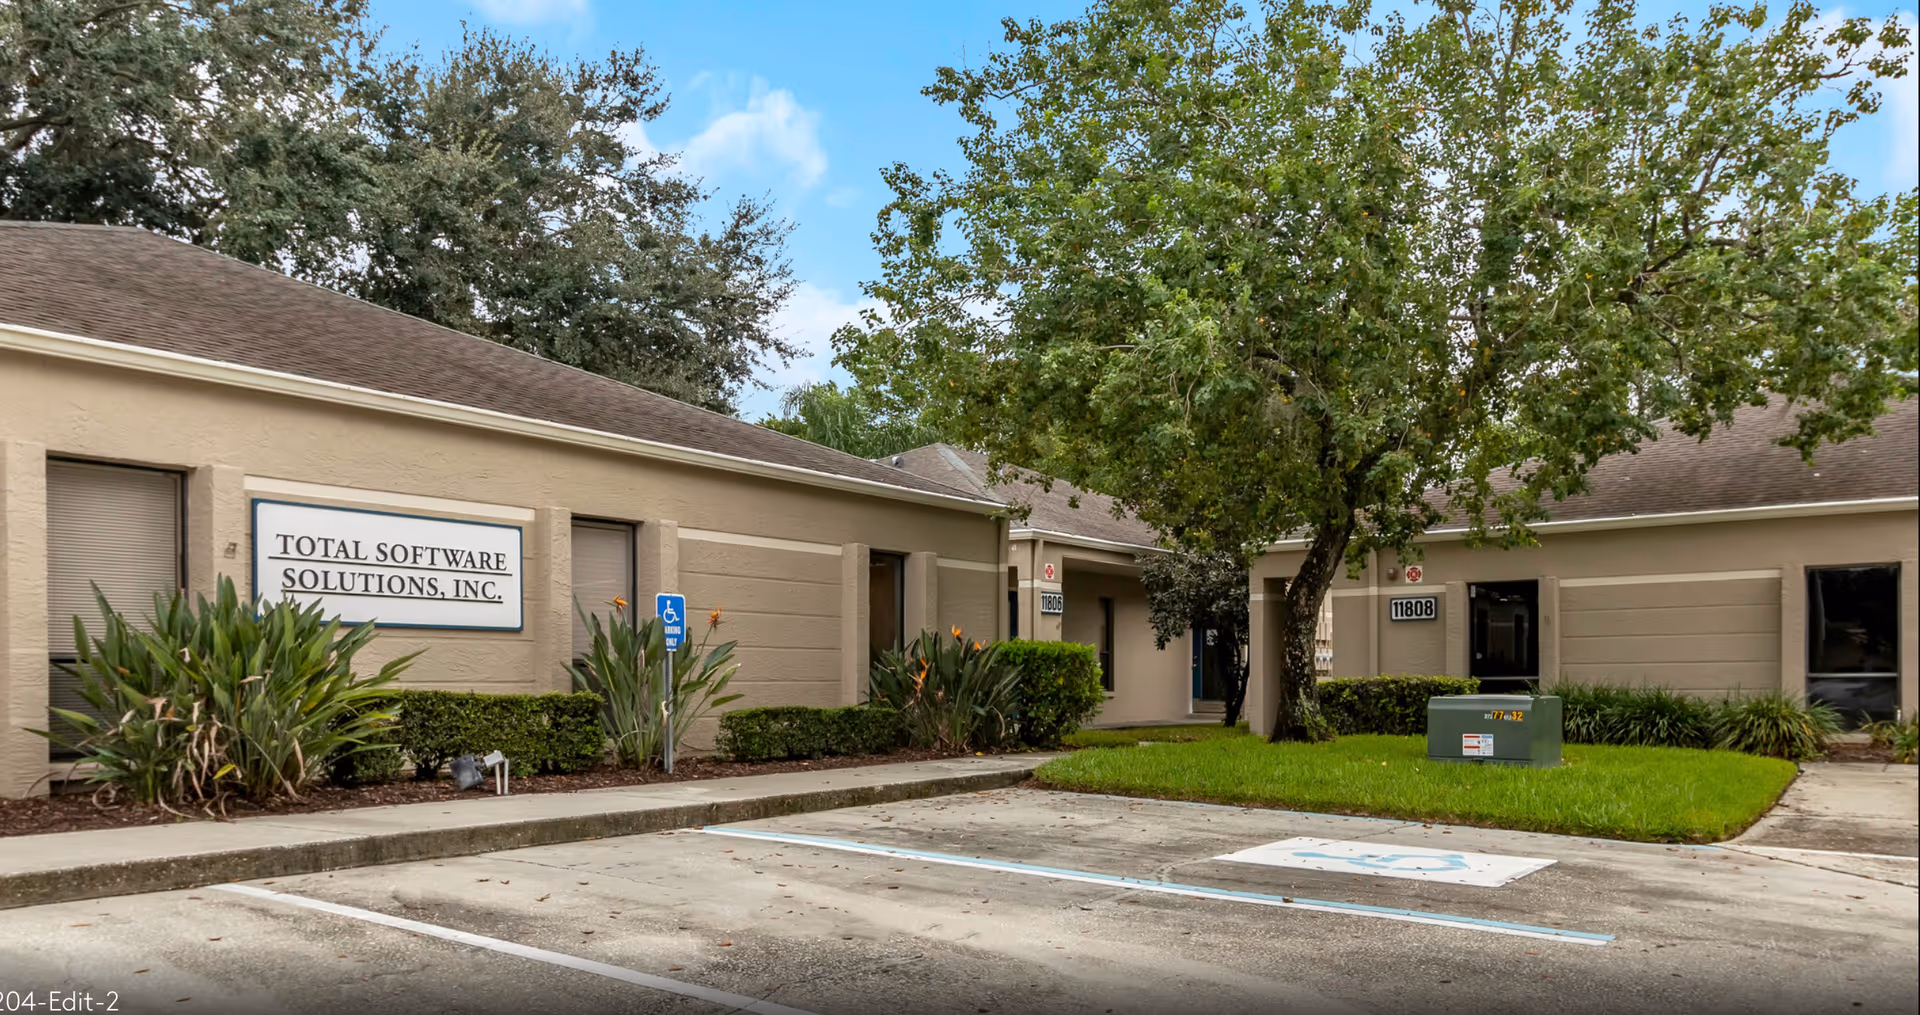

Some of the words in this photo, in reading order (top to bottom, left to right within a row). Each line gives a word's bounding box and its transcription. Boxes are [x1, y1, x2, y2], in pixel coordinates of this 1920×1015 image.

[275, 533, 368, 561] TOTAL
[375, 542, 508, 572] SOFTWARE
[282, 567, 446, 599] SOLUTIONS,
[452, 578, 503, 601] INC.
[1041, 595, 1062, 611] 11806
[1393, 600, 1434, 617] 11808
[665, 626, 681, 634] ARKING
[665, 638, 677, 646] ONLY
